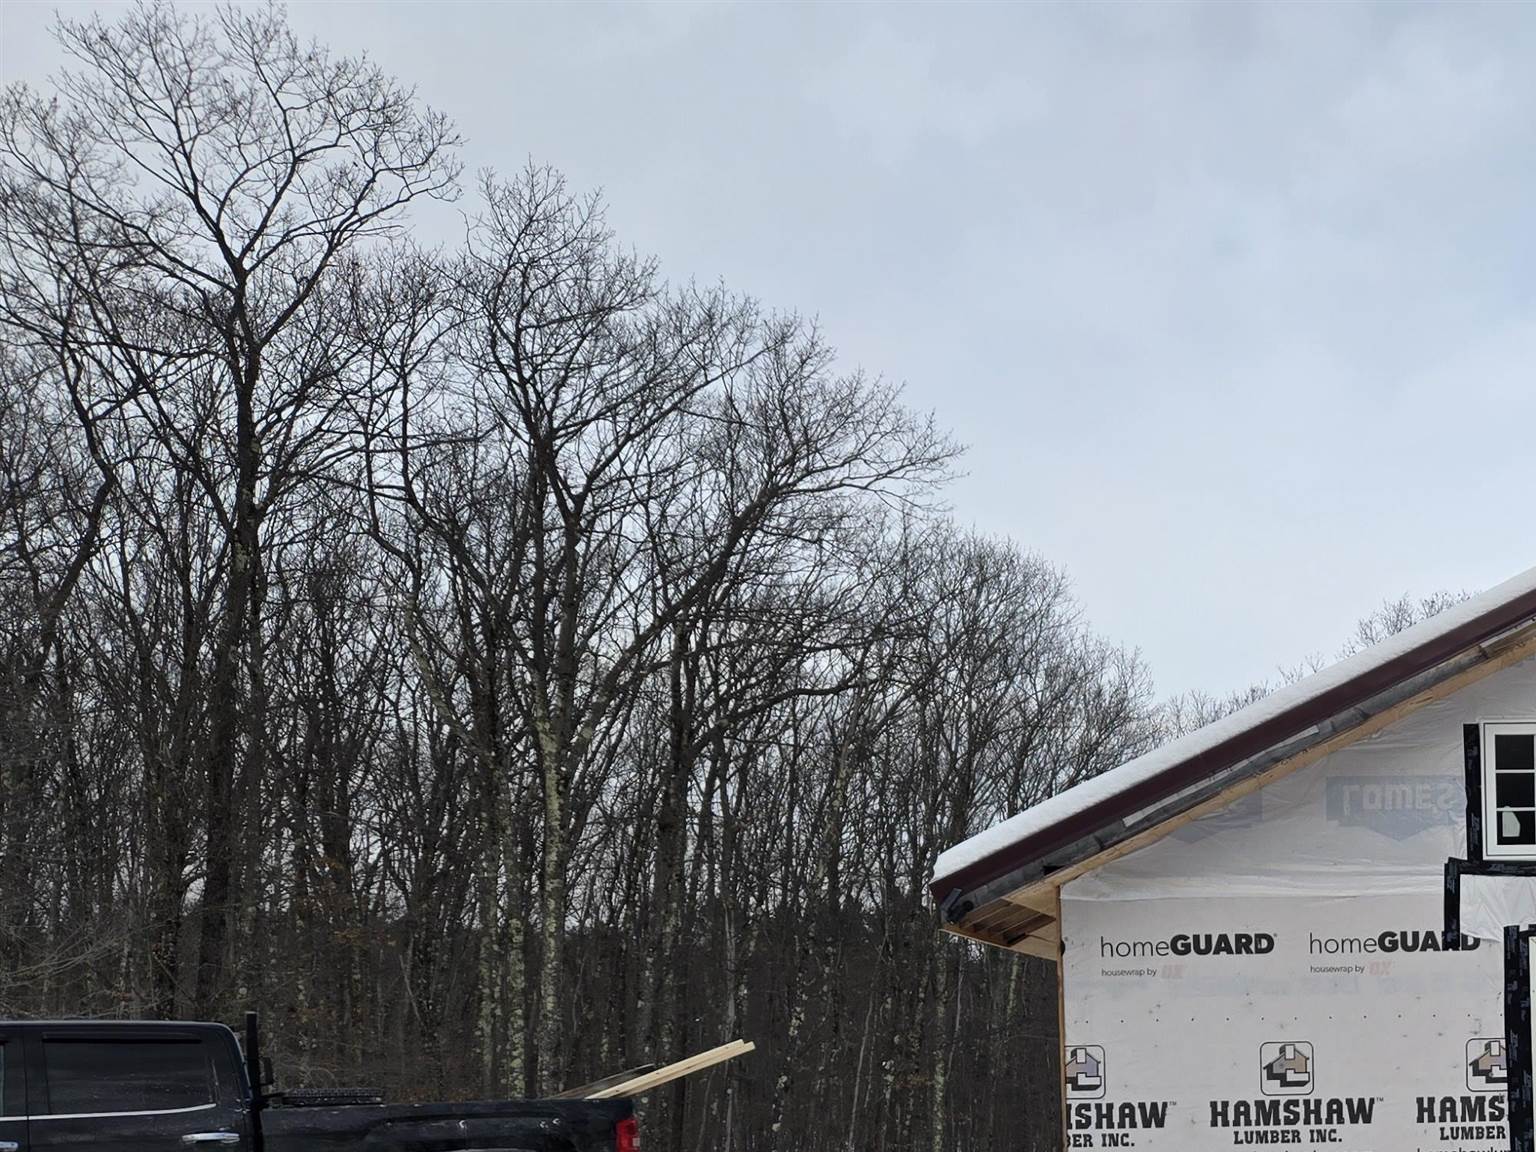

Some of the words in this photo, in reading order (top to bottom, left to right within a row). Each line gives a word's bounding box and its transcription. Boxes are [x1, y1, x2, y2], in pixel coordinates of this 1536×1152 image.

[1101, 933, 1275, 957] homeGUARD
[1310, 931, 1481, 954] homeGUAD
[1101, 967, 1145, 977] housewrap
[1147, 967, 1157, 977] by
[1310, 965, 1353, 974] housewrap
[1355, 964, 1365, 974] by
[1210, 1097, 1375, 1127] HAMSHAW
[1101, 1133, 1135, 1147] INC.
[1233, 1130, 1301, 1144] LUMBER
[1309, 1129, 1343, 1142] INC.
[1440, 1126, 1507, 1140] LUMBER
